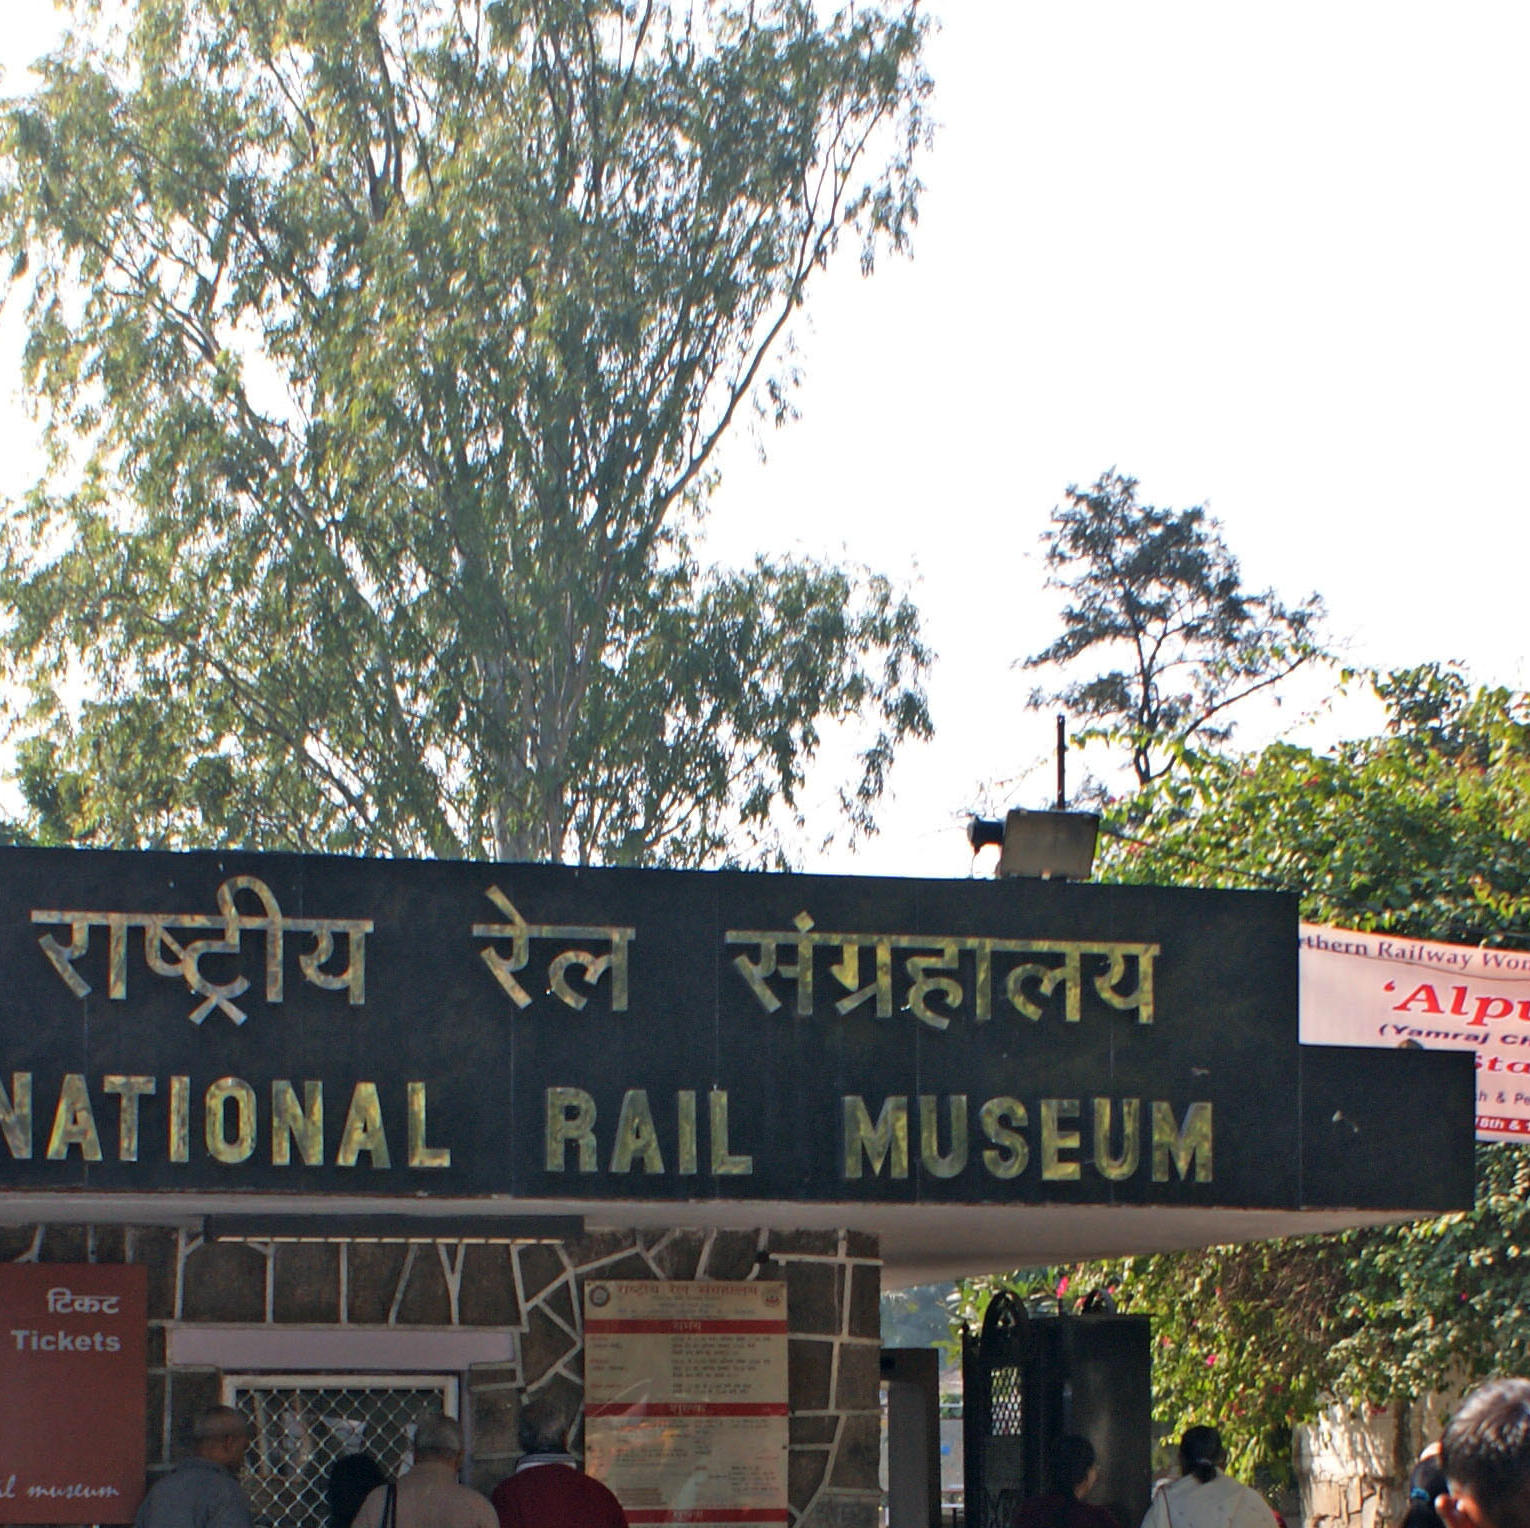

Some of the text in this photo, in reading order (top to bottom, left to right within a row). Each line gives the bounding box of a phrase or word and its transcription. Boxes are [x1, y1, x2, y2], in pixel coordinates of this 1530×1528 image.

[30, 876, 1161, 1031] राष्ट्रीय रेल संग्रहालय
[1378, 941, 1472, 970] Railway
[1379, 1023, 1491, 1046] (Yamraj
[544, 1086, 754, 1176] RAIL
[844, 1094, 1214, 1183] MUSEUM
[47, 1287, 119, 1314] टिकट
[11, 1329, 121, 1352] Tickets
[27, 1482, 120, 1499] museum
